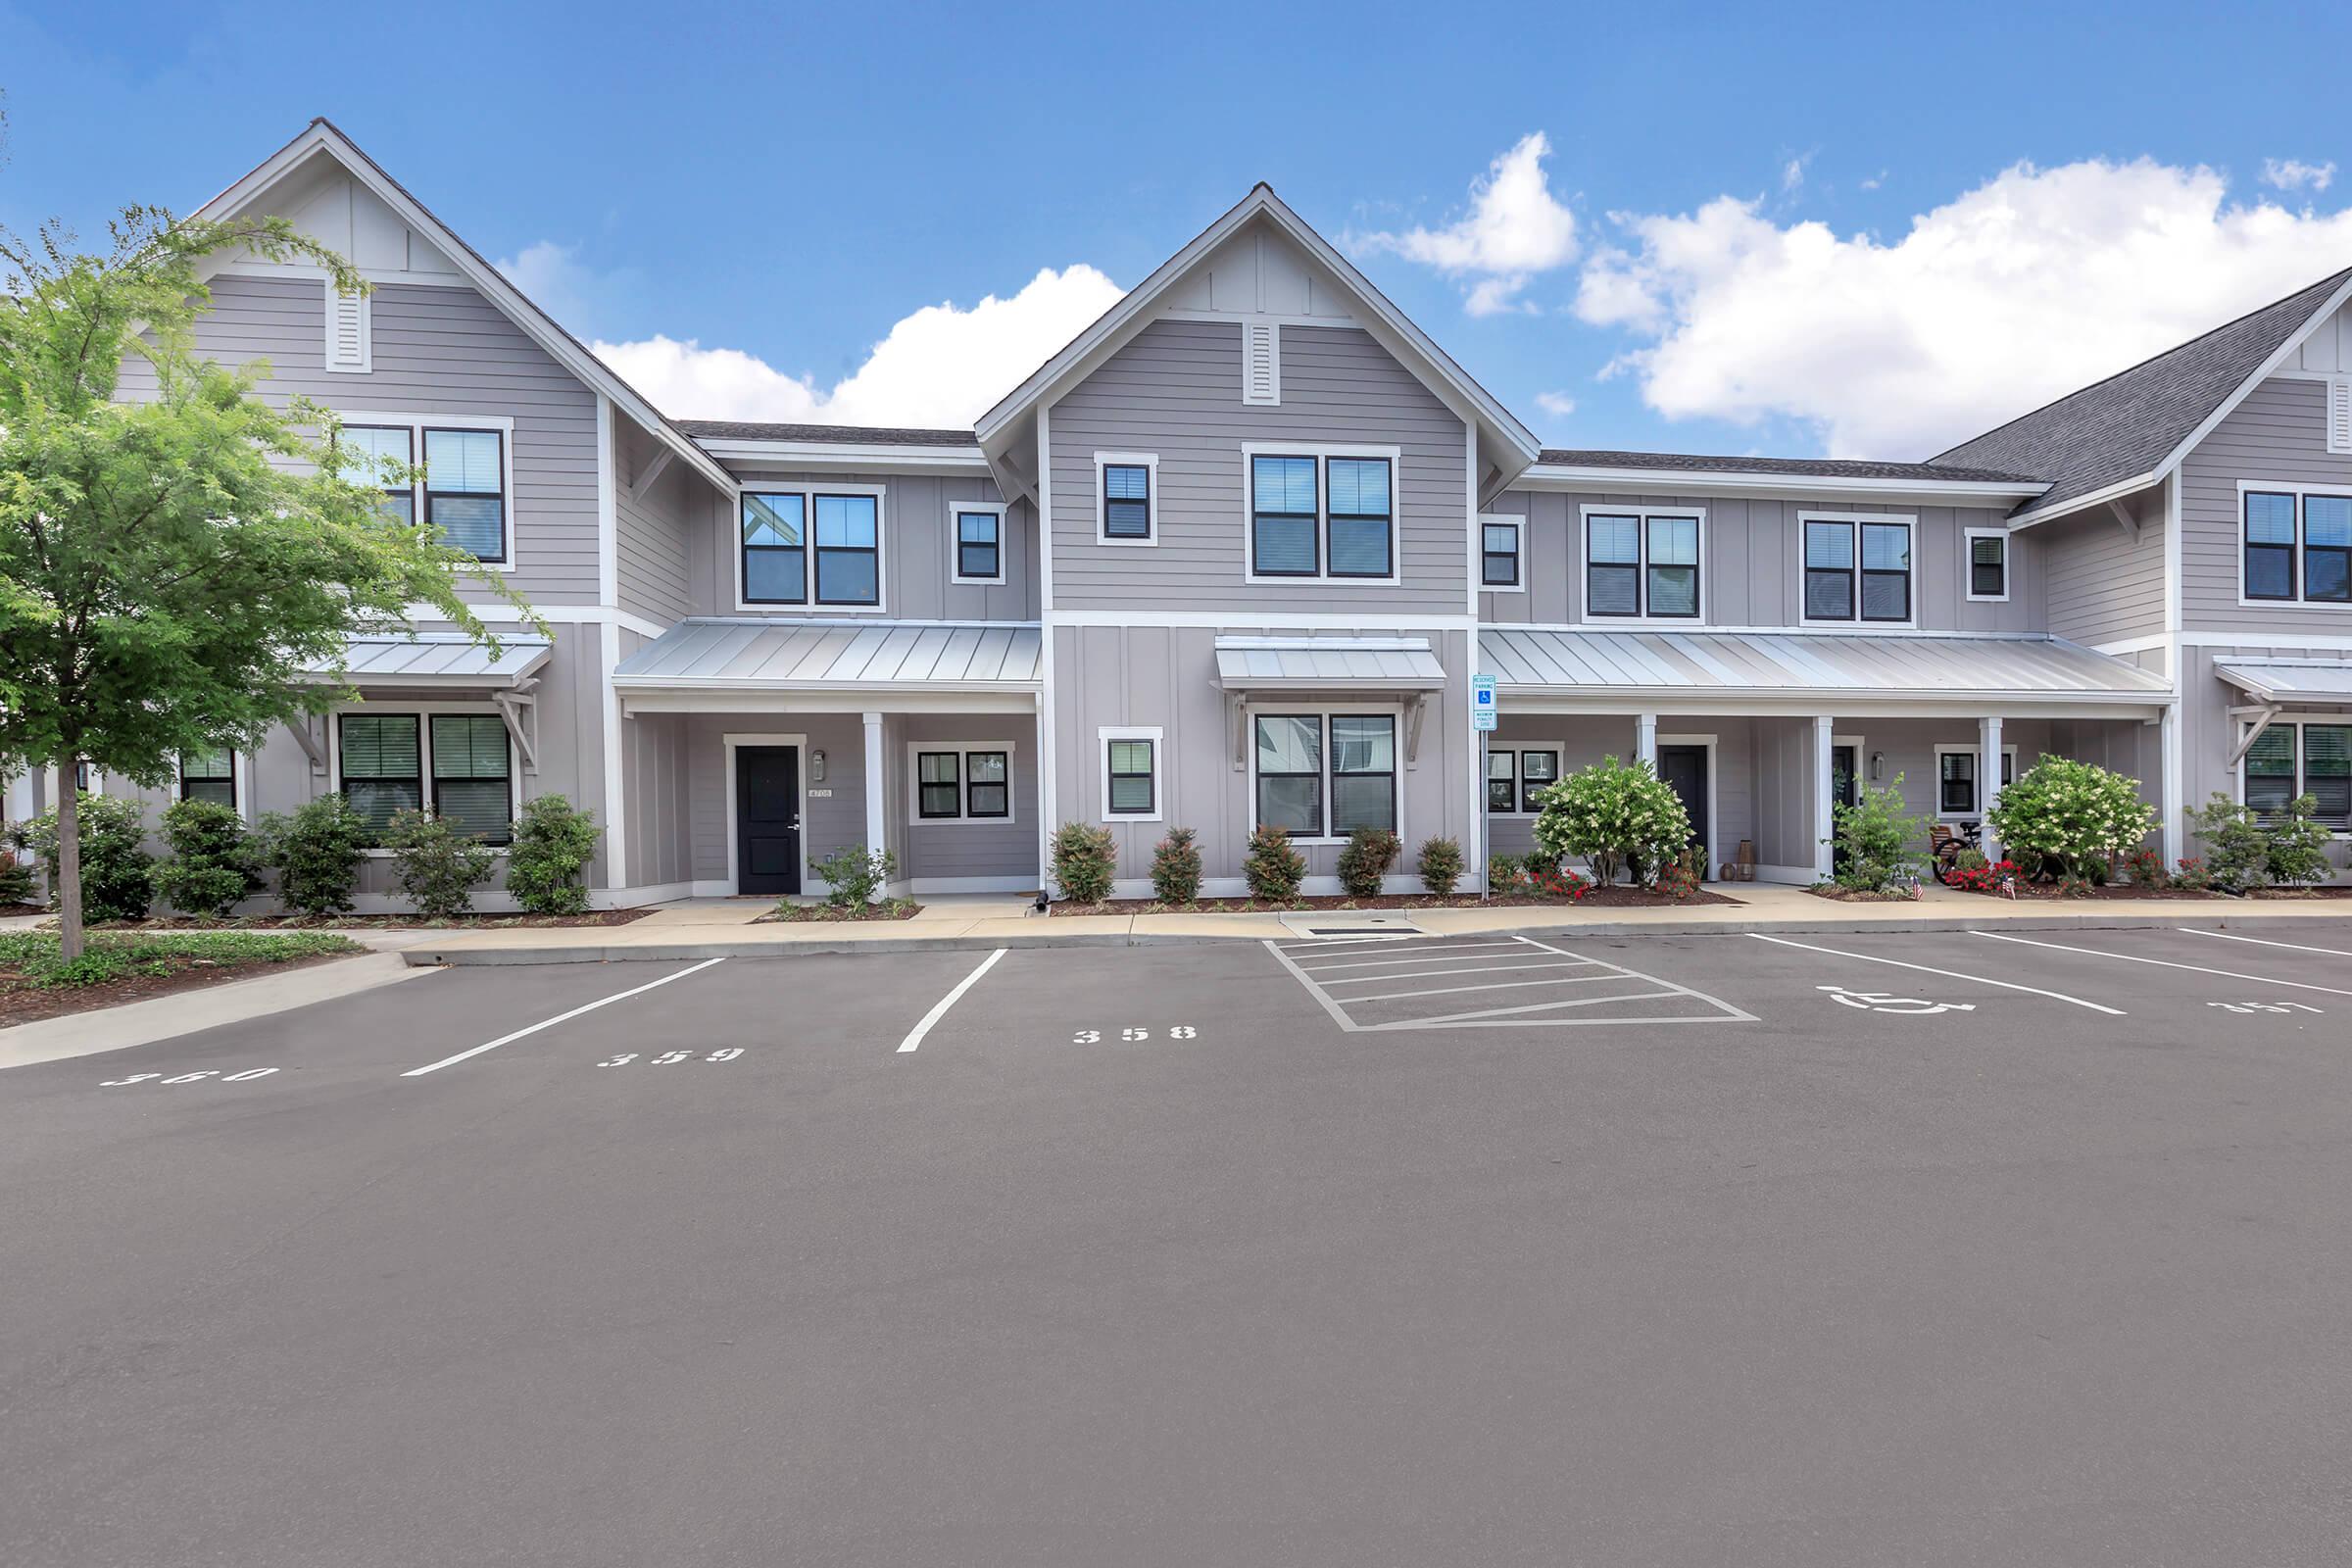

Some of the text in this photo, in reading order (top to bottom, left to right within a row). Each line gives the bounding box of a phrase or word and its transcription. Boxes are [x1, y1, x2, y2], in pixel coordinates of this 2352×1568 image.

[2206, 1002, 2324, 1013] 357
[1074, 1026, 1197, 1044] 358
[597, 1048, 745, 1067] 359
[99, 1067, 280, 1086] 360
